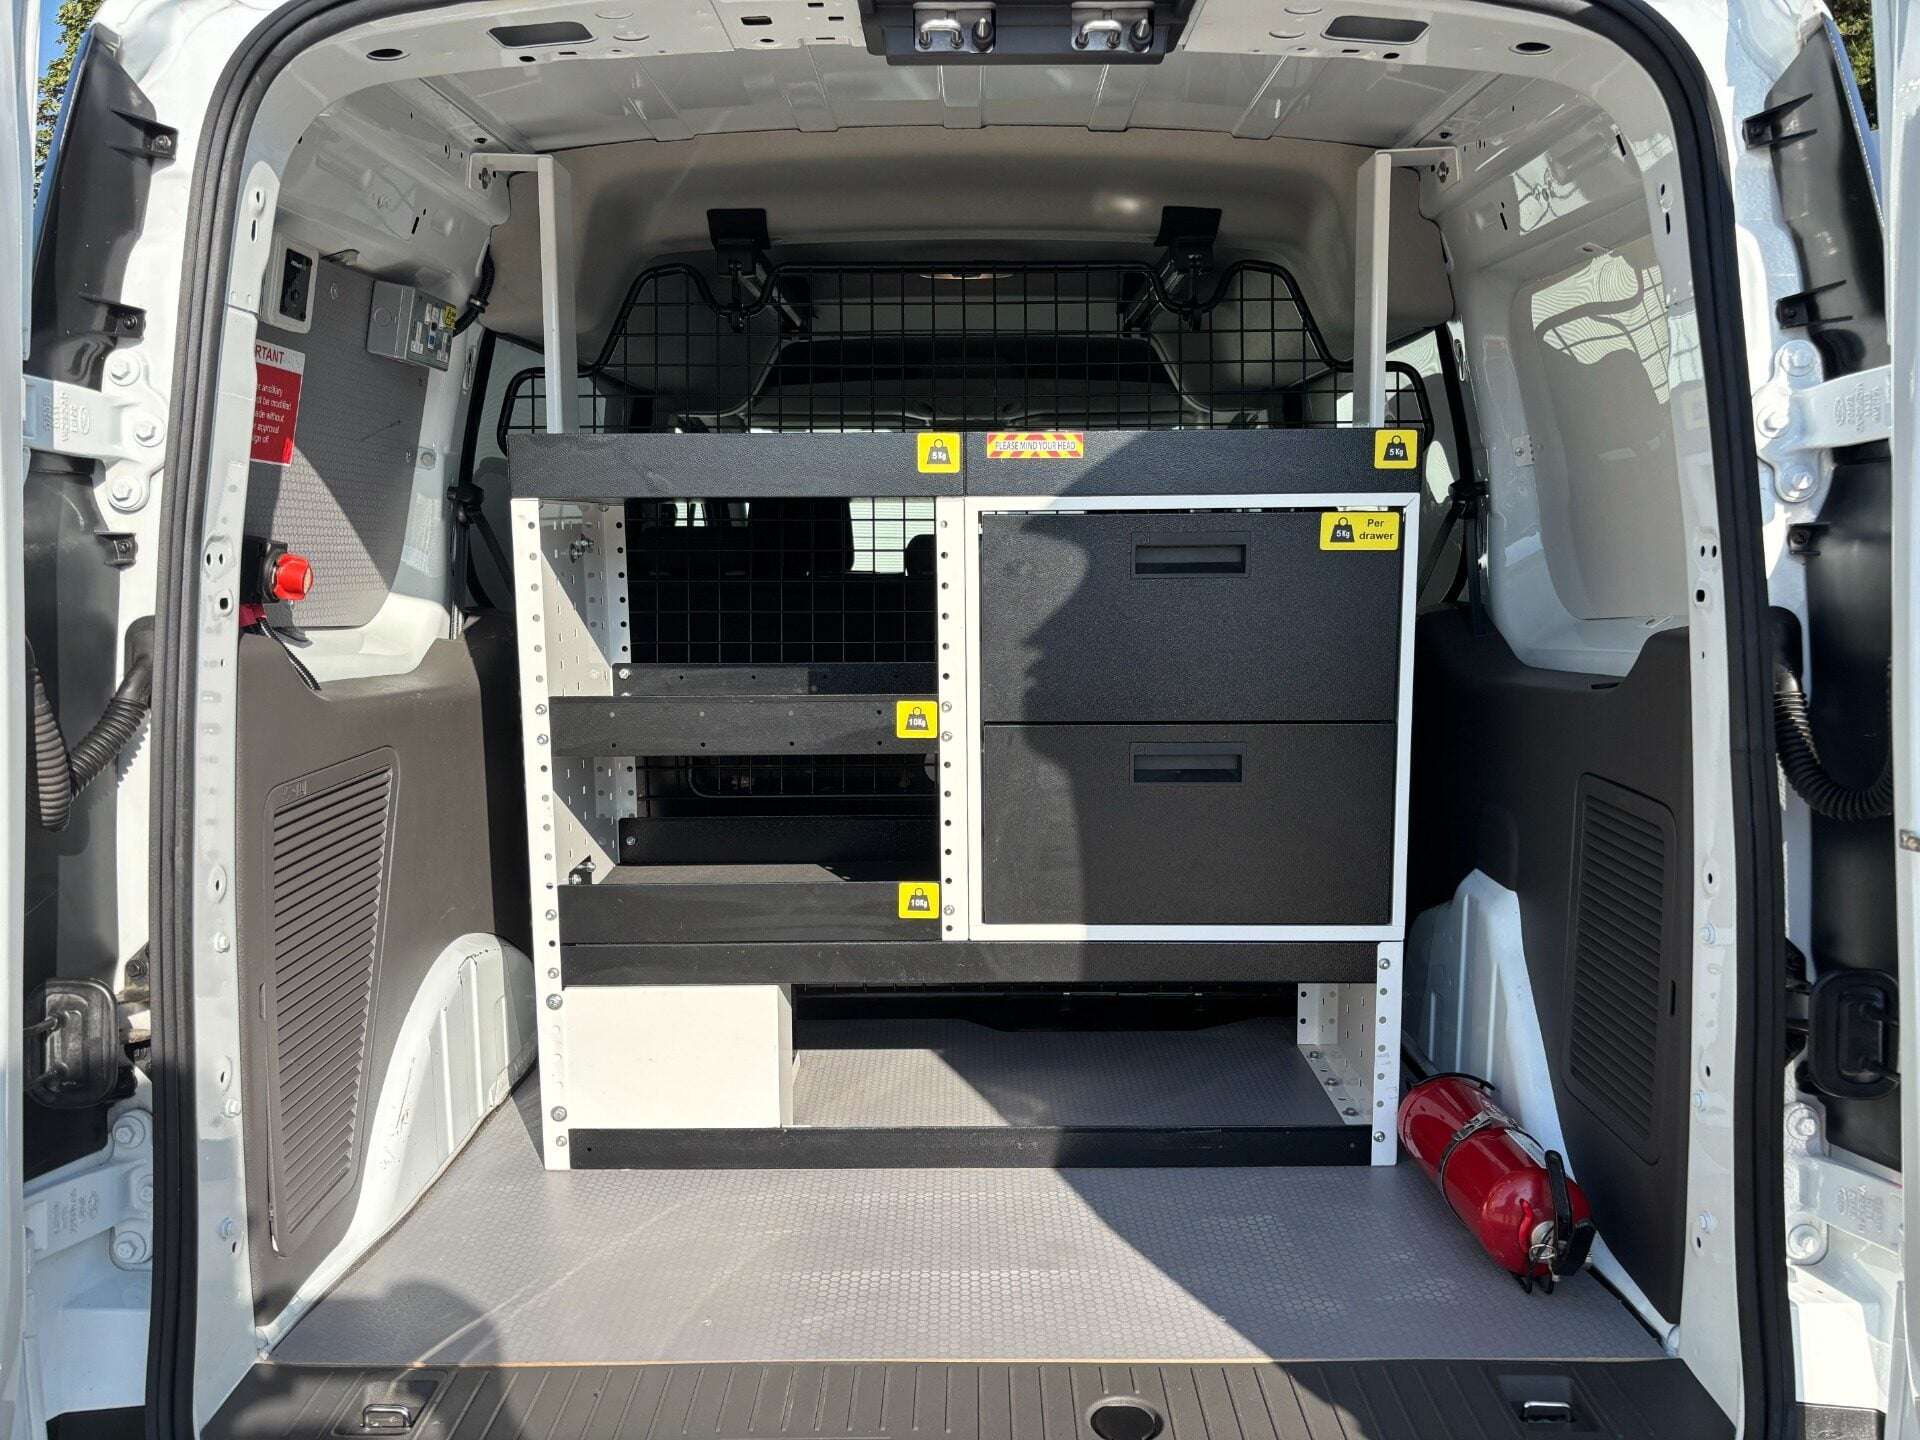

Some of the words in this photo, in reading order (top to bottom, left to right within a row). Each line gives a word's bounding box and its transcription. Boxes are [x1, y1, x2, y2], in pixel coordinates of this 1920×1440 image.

[995, 440, 1019, 450] PLEASE
[1020, 440, 1038, 450] MIND
[1039, 440, 1056, 450] YOUR
[1057, 440, 1076, 450] HEAD
[1367, 518, 1385, 527] Per
[1359, 531, 1394, 540] drawer
